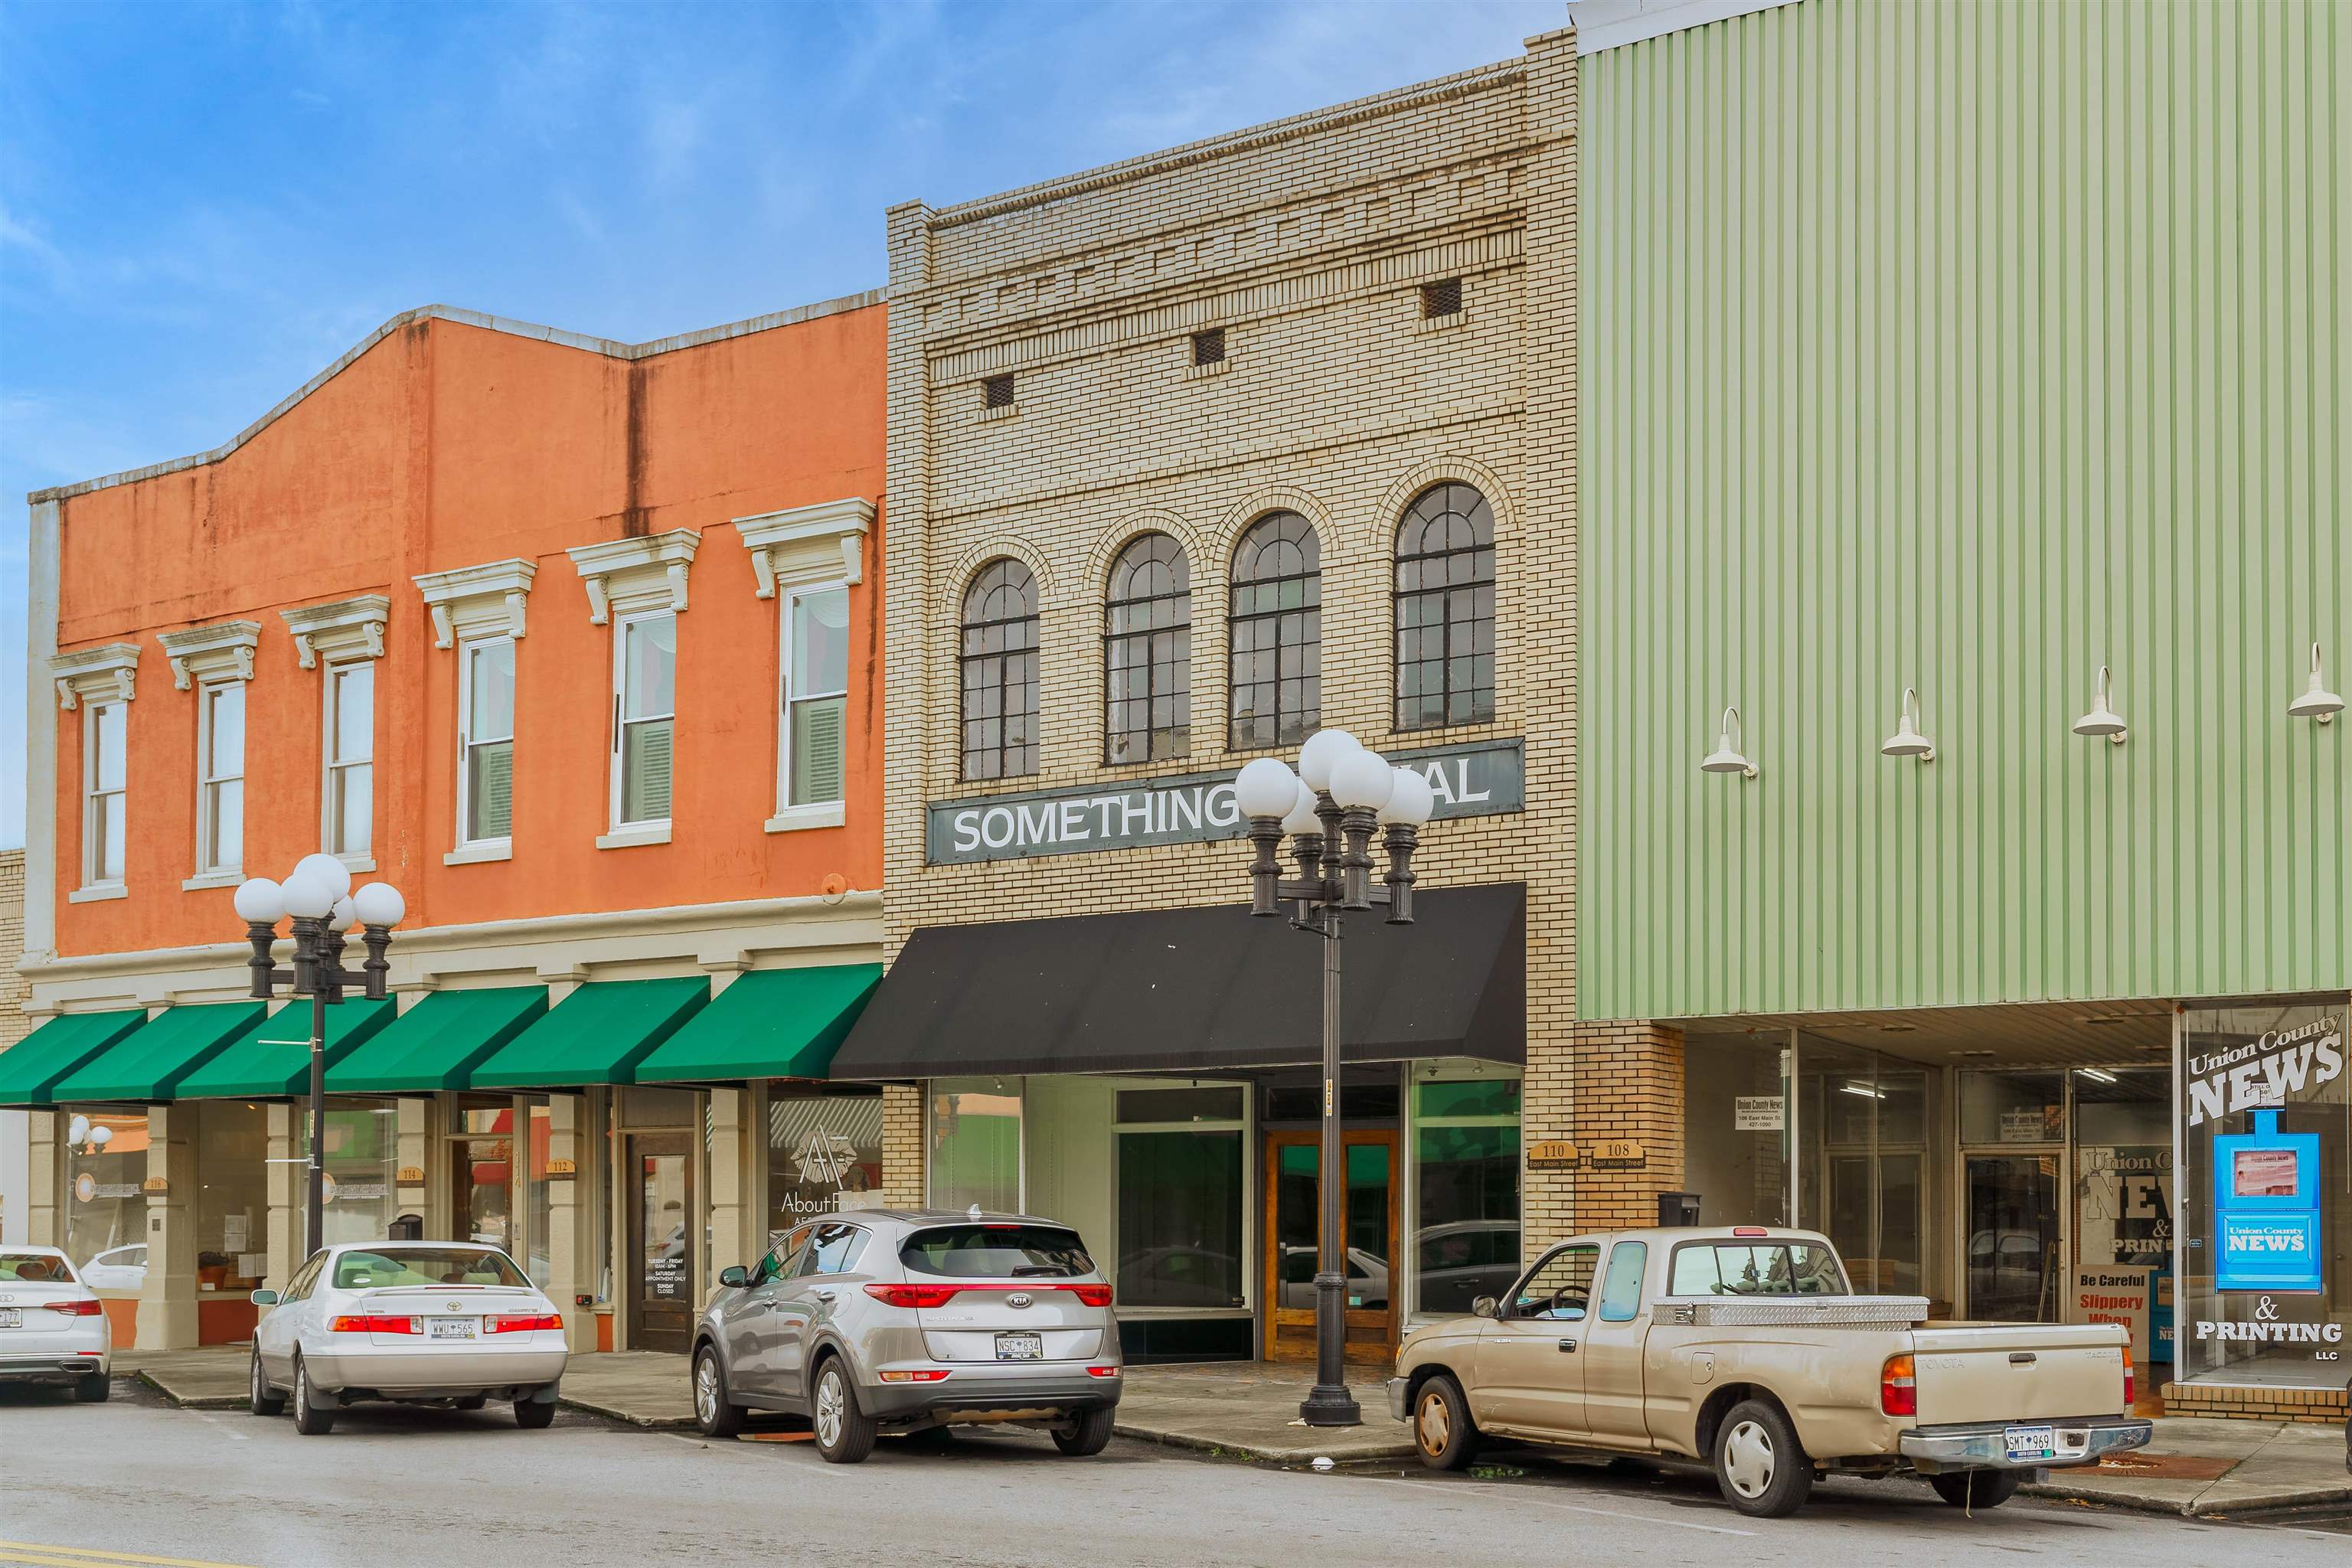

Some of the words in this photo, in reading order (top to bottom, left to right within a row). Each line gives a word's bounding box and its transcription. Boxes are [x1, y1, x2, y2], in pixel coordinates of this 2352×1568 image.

[954, 783, 1240, 852] SOMETHING
[2188, 1043, 2257, 1075] Union
[2259, 1011, 2344, 1051] County
[2189, 1032, 2343, 1126] NEWS
[1738, 1099, 1752, 1109] Union
[1753, 1099, 1769, 1110] County
[1770, 1099, 1783, 1109] News
[1544, 1145, 1564, 1157] 110
[1608, 1145, 1629, 1156] 108
[554, 1161, 567, 1171] 112
[2086, 1152, 2153, 1171] Union
[404, 1170, 416, 1179] 114
[2152, 1219, 2171, 1237] &
[2229, 1235, 2305, 1252] NEWS
[2080, 1275, 2096, 1286] Be
[2099, 1275, 2145, 1286] Careful
[2080, 1294, 2143, 1310] Slippery
[2255, 1295, 2280, 1321] &
[2089, 1314, 2132, 1328] When
[433, 1324, 449, 1334] WWU
[457, 1324, 473, 1334] 565
[2196, 1321, 2342, 1343] PRINTING
[999, 1341, 1015, 1351] NSC
[1024, 1340, 1039, 1351] 834
[2315, 1351, 2338, 1361] LLC
[1918, 1358, 1965, 1369] TOYOTA
[2009, 1436, 2024, 1451] SMT
[2033, 1434, 2050, 1449] 969
